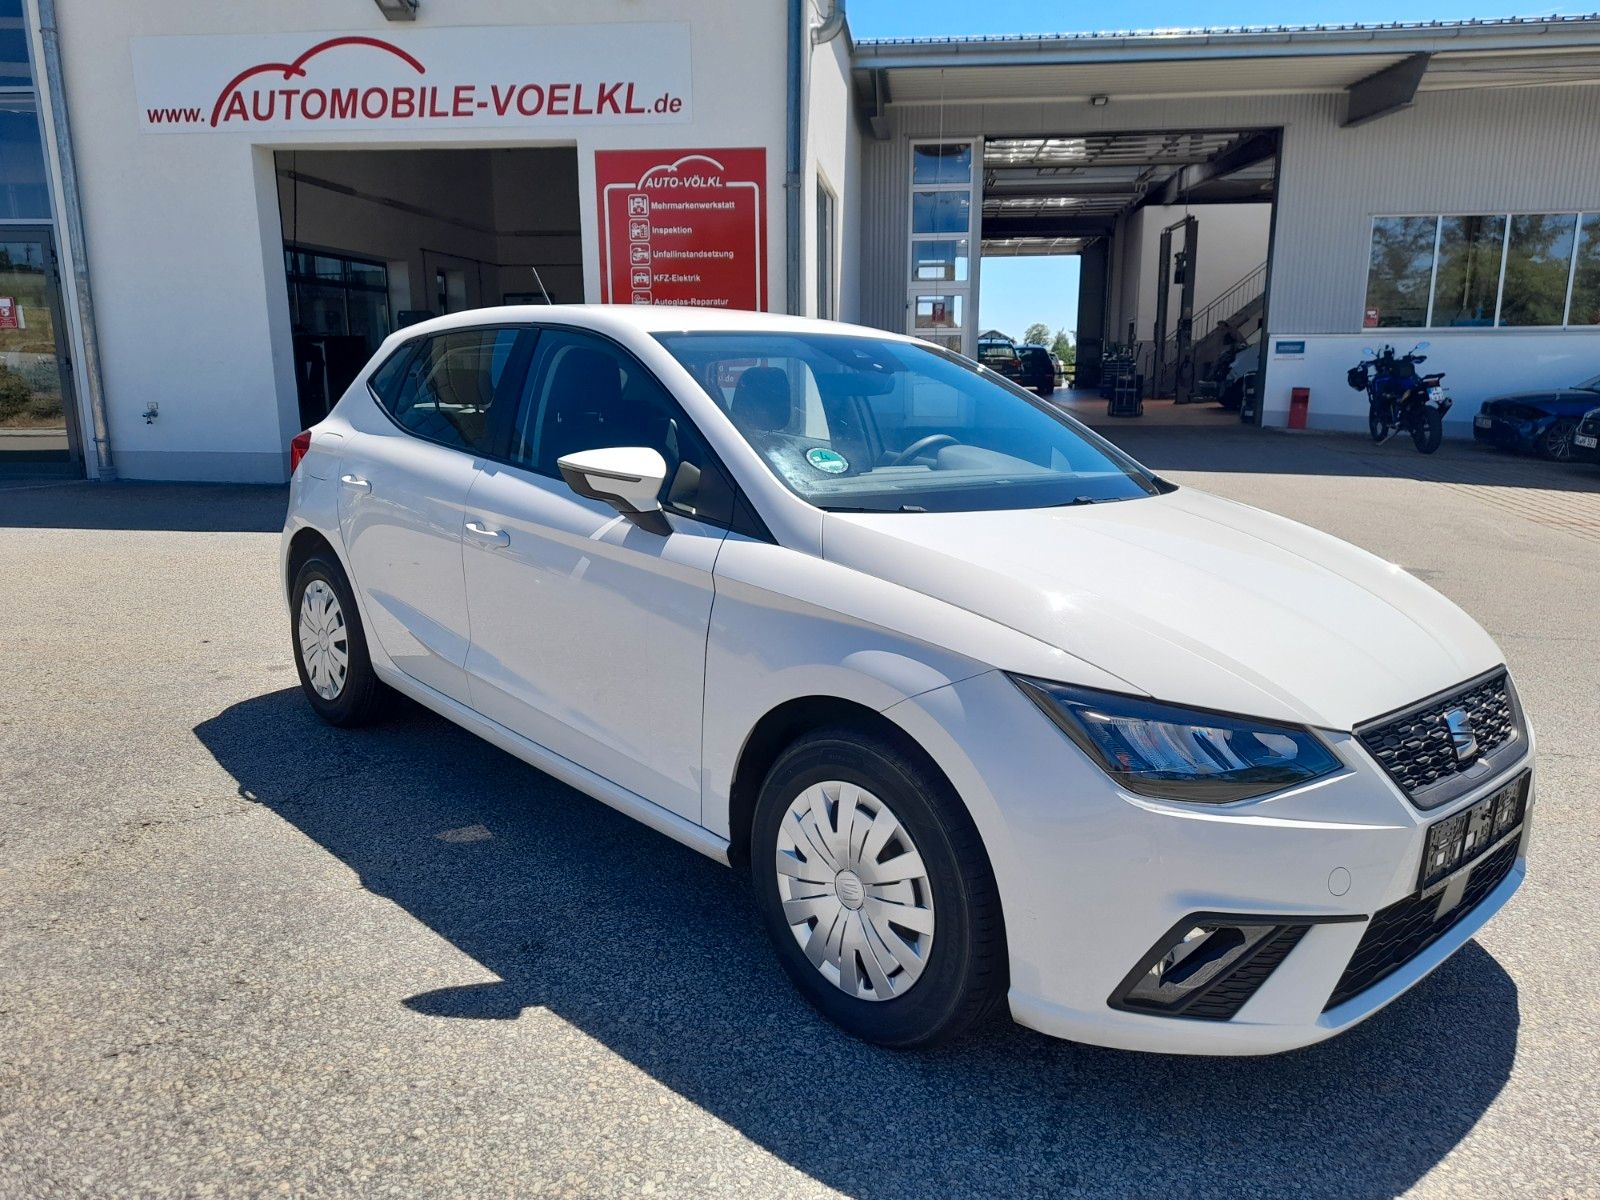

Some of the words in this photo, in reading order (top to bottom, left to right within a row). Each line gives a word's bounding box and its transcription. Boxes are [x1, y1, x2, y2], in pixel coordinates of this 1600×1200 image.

[645, 174, 723, 188] AUTO-VÖLKL
[651, 201, 735, 210] Mehrmarkenwerkstatt
[652, 226, 692, 235] Inspektion
[653, 250, 734, 259] Unfallinstandsetzung
[653, 274, 701, 282] KFZ-Elektrik
[654, 297, 729, 306] Autoglas-Reparatur
[820, 451, 830, 460] 4
